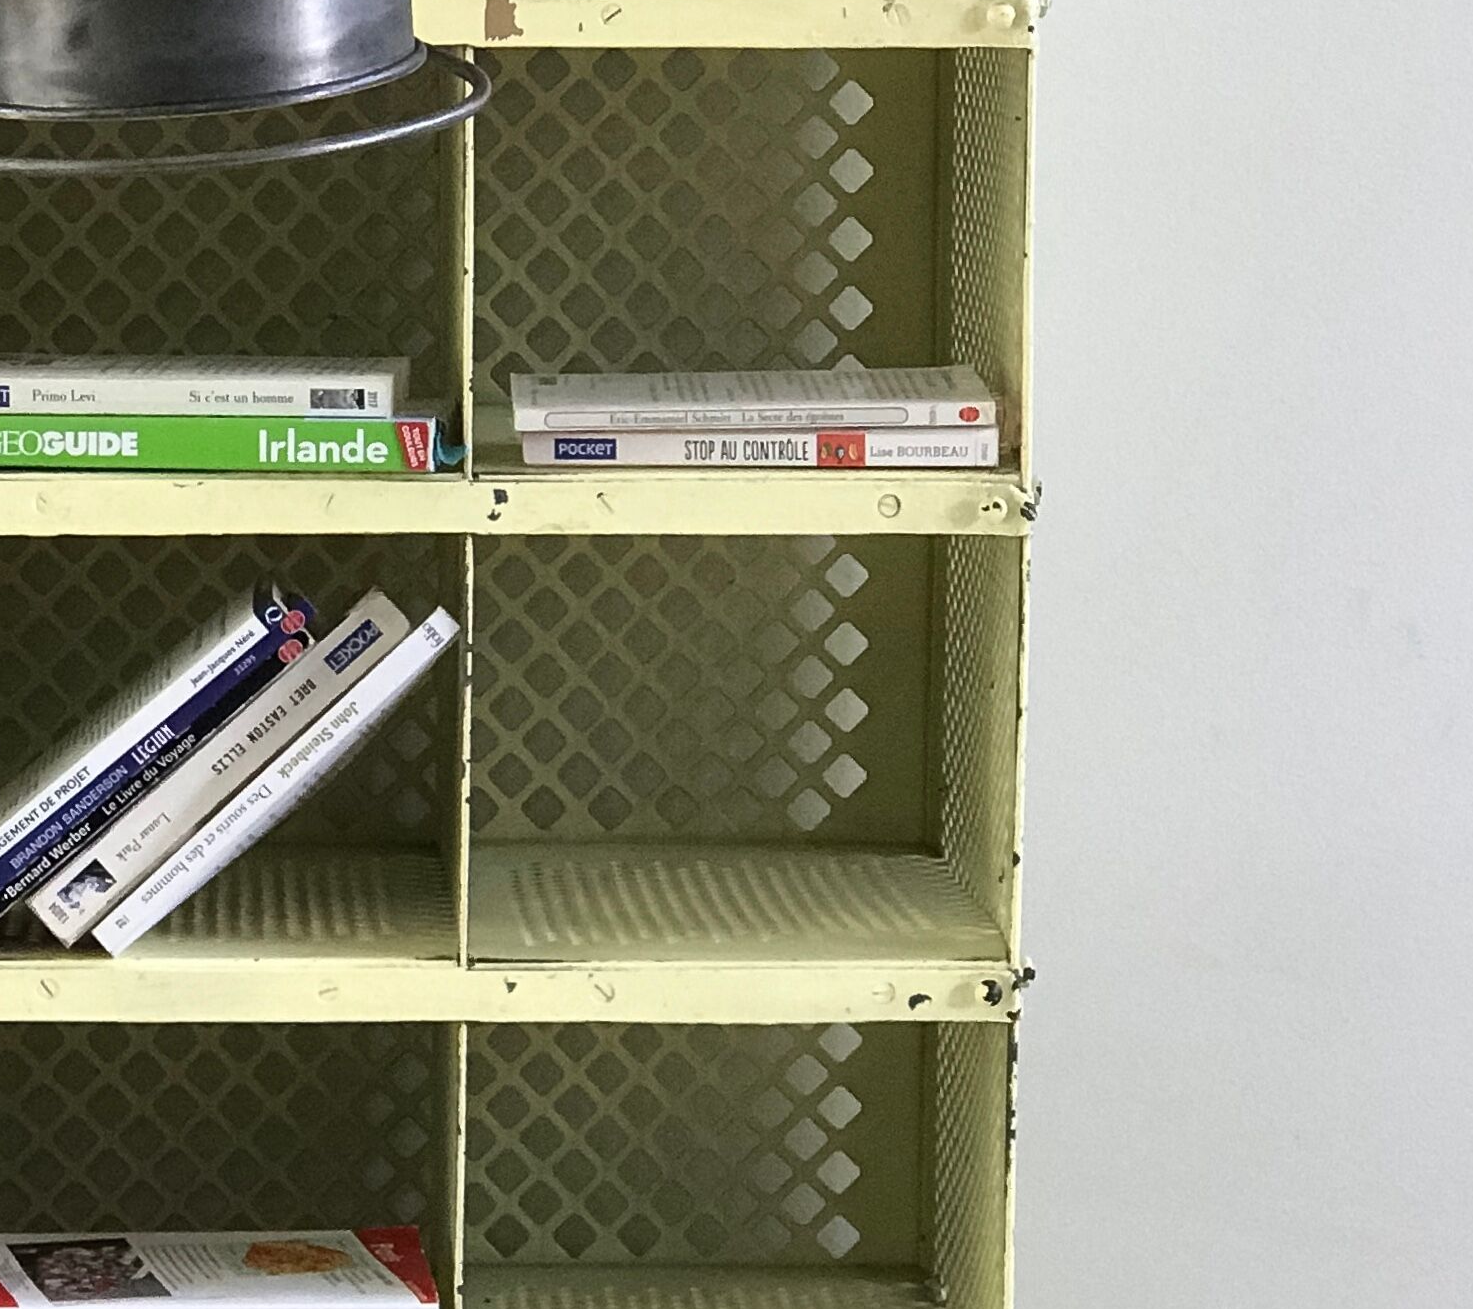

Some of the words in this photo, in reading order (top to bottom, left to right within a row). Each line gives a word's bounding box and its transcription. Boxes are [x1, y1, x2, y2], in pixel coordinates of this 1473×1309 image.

[32, 389, 67, 402] Primo
[71, 390, 96, 403] Levi
[189, 391, 201, 403] Si
[205, 390, 230, 403] c'est
[234, 394, 249, 403] un
[252, 391, 294, 404] homme
[258, 428, 388, 463] Irlande
[558, 442, 613, 455] POCKET
[684, 440, 715, 461] STOP
[720, 440, 737, 460] AU
[743, 438, 809, 461] CONTRÔLE
[897, 445, 968, 457] BOURBEAU
[328, 622, 379, 672] POCKET
[422, 622, 445, 648] folio
[289, 678, 317, 706] BRET
[39, 797, 56, 813] DE
[55, 766, 92, 800] PROJET
[190, 646, 236, 687] Jean-Jacques
[246, 705, 287, 744] EASTON
[330, 701, 360, 730] John
[211, 742, 246, 776] ELLIS
[278, 727, 334, 779] Steinbeck
[247, 783, 272, 805] Des
[5, 862, 51, 899] Bernard
[49, 822, 92, 860] Werber
[101, 801, 117, 816] Le
[115, 777, 143, 804] Livre
[143, 766, 159, 783] du
[157, 734, 197, 768] Voyage
[9, 821, 64, 870] BRANDON
[62, 765, 129, 825] SANDERSON
[215, 803, 248, 835] souris
[115, 838, 142, 863] Park
[185, 845, 208, 864] des
[204, 832, 216, 847] et
[140, 862, 191, 905] hommes
